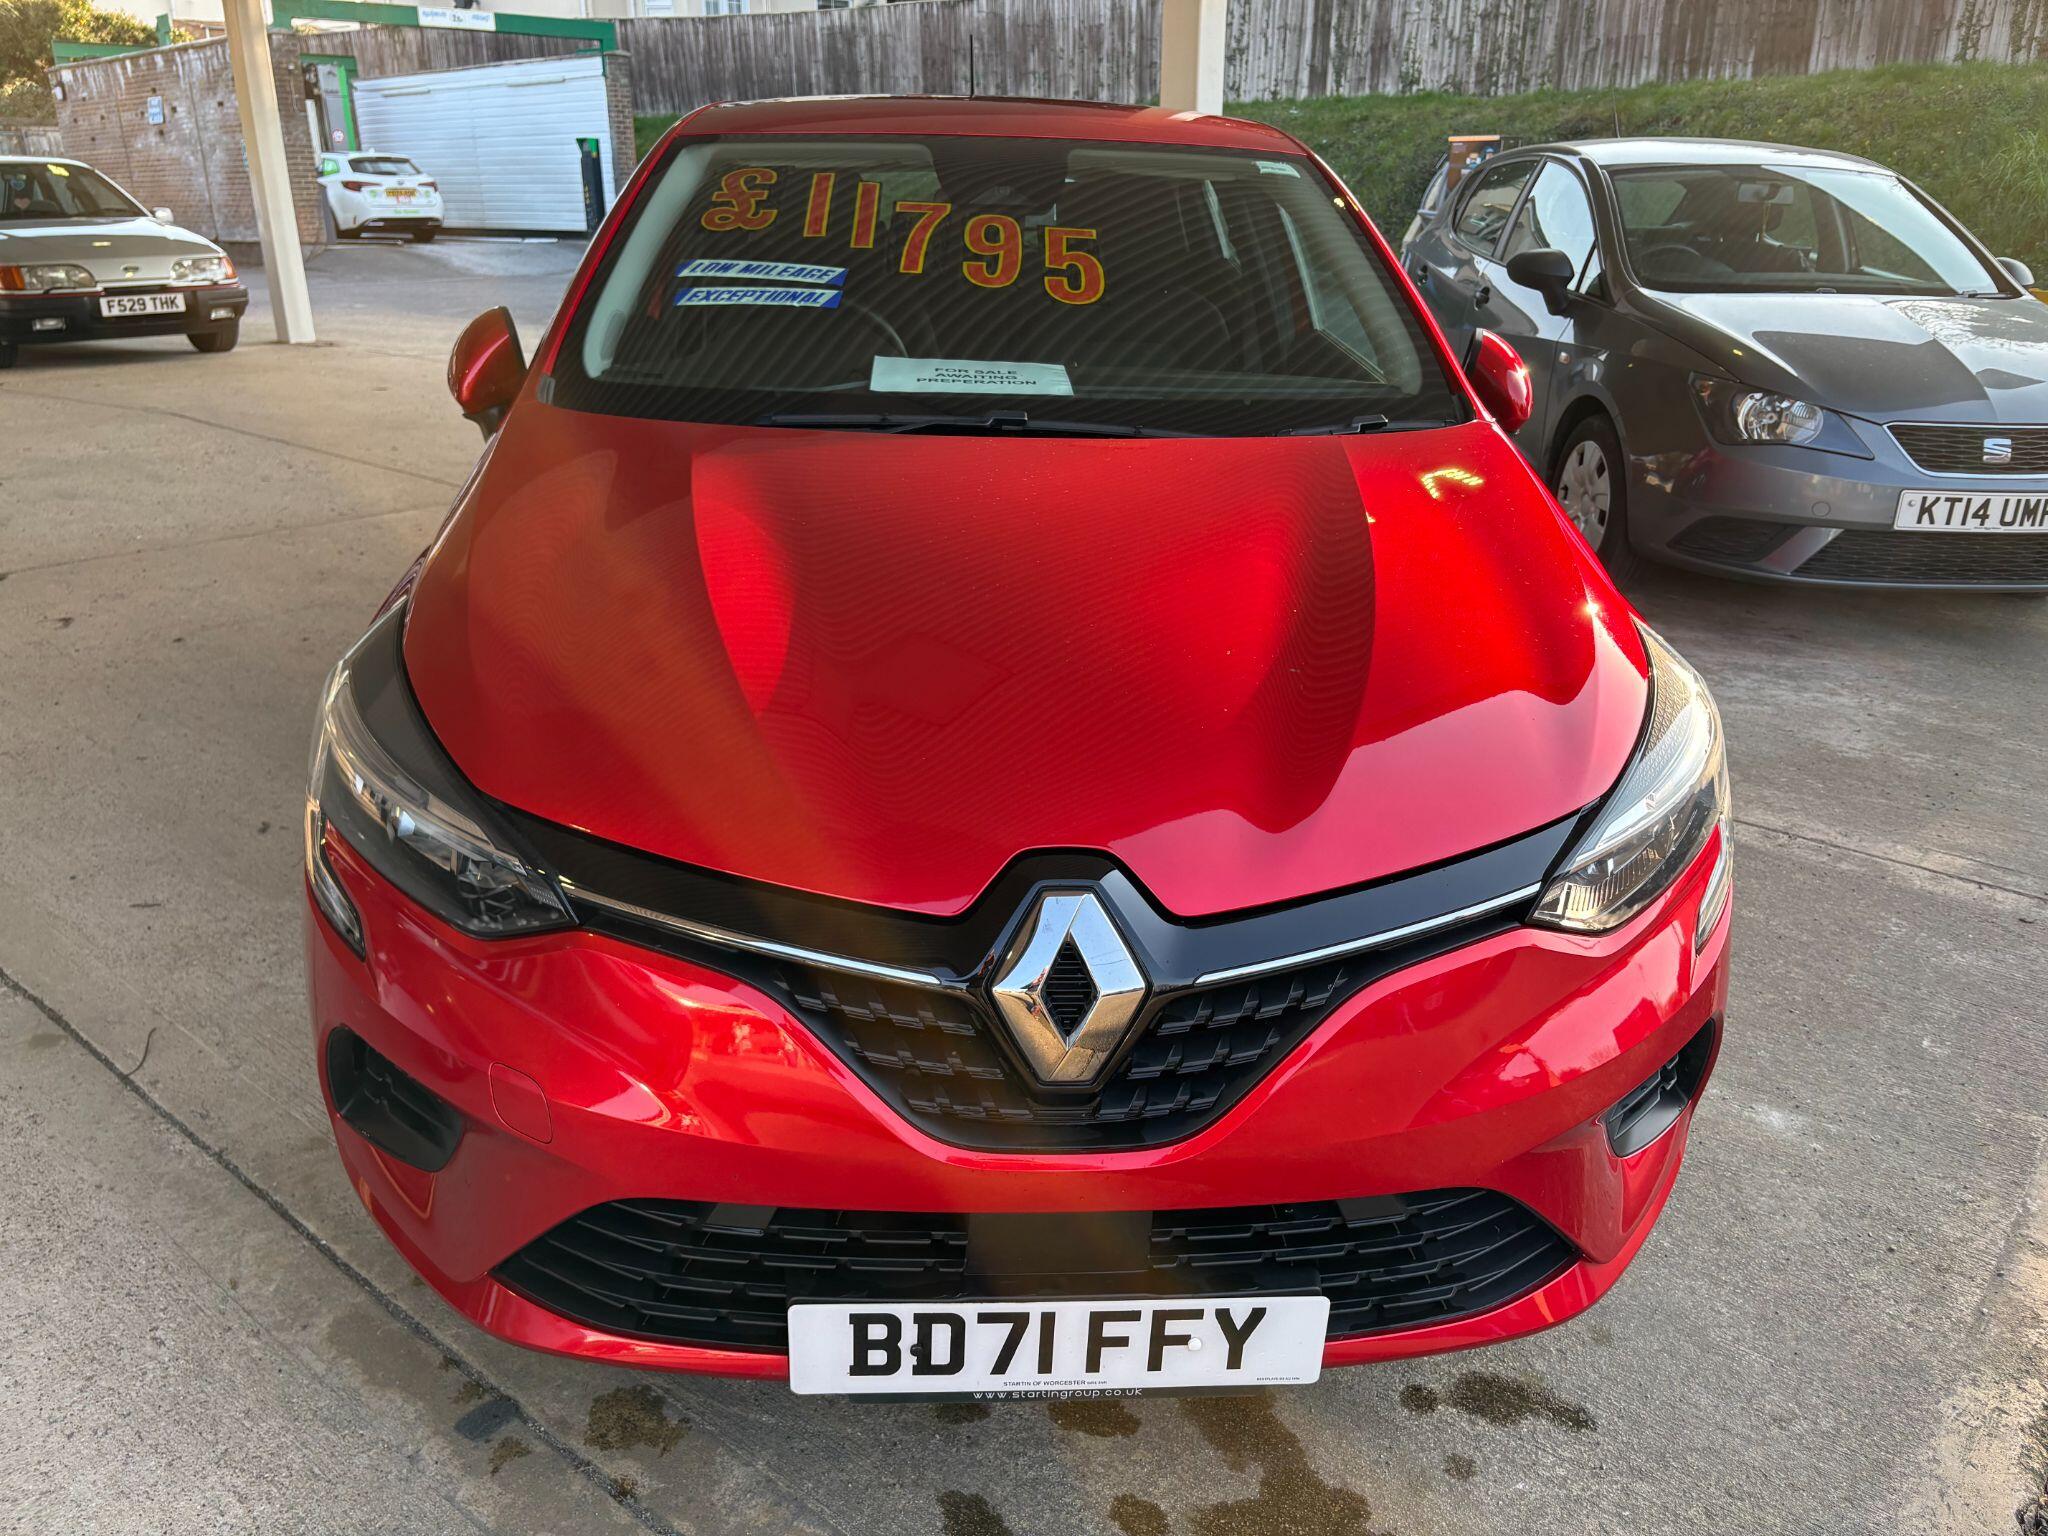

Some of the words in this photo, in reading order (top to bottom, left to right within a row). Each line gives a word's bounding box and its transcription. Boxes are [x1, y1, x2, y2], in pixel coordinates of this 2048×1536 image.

[700, 167, 1105, 305] £11795
[689, 261, 737, 274] LOW
[740, 263, 837, 280] MILEAGE
[106, 297, 147, 313] F529
[150, 295, 180, 310] THK
[686, 289, 827, 304] EXCEPTIONAL
[1916, 496, 1992, 526] KT14
[849, 1311, 1057, 1376] BD71
[1084, 1306, 1267, 1373] FFY
[973, 1387, 1142, 1399] www.startingroup.co.uk
